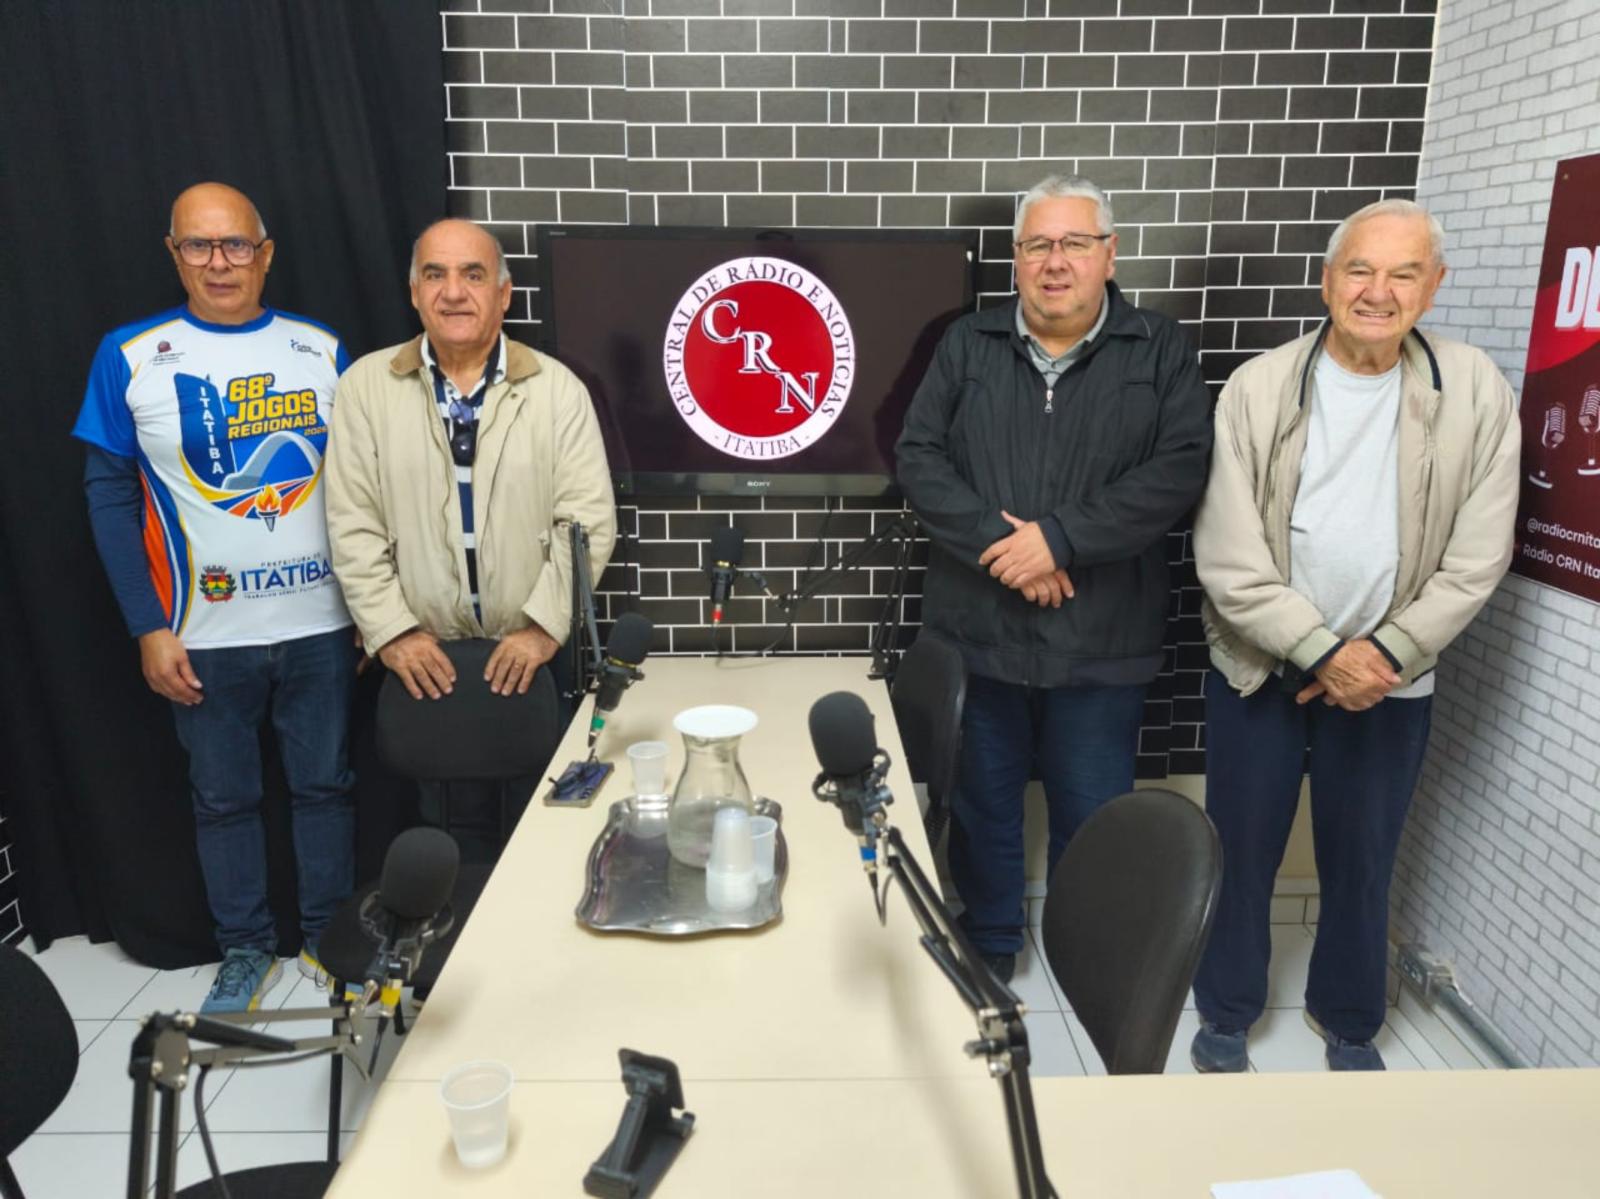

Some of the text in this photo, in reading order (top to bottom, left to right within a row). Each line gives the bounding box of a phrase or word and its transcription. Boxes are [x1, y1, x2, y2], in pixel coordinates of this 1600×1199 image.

[667, 308, 697, 416] CENTRAL
[692, 274, 722, 304] DE
[726, 259, 804, 289] RÁDIO
[807, 283, 823, 303] E
[228, 391, 317, 425] JOGOS
[200, 385, 224, 474] ITATIBA
[228, 413, 317, 439] REGIONAIS
[724, 434, 801, 456] ITATIBA
[240, 559, 333, 591] ITATIBA
[1556, 554, 1582, 573] CRN
